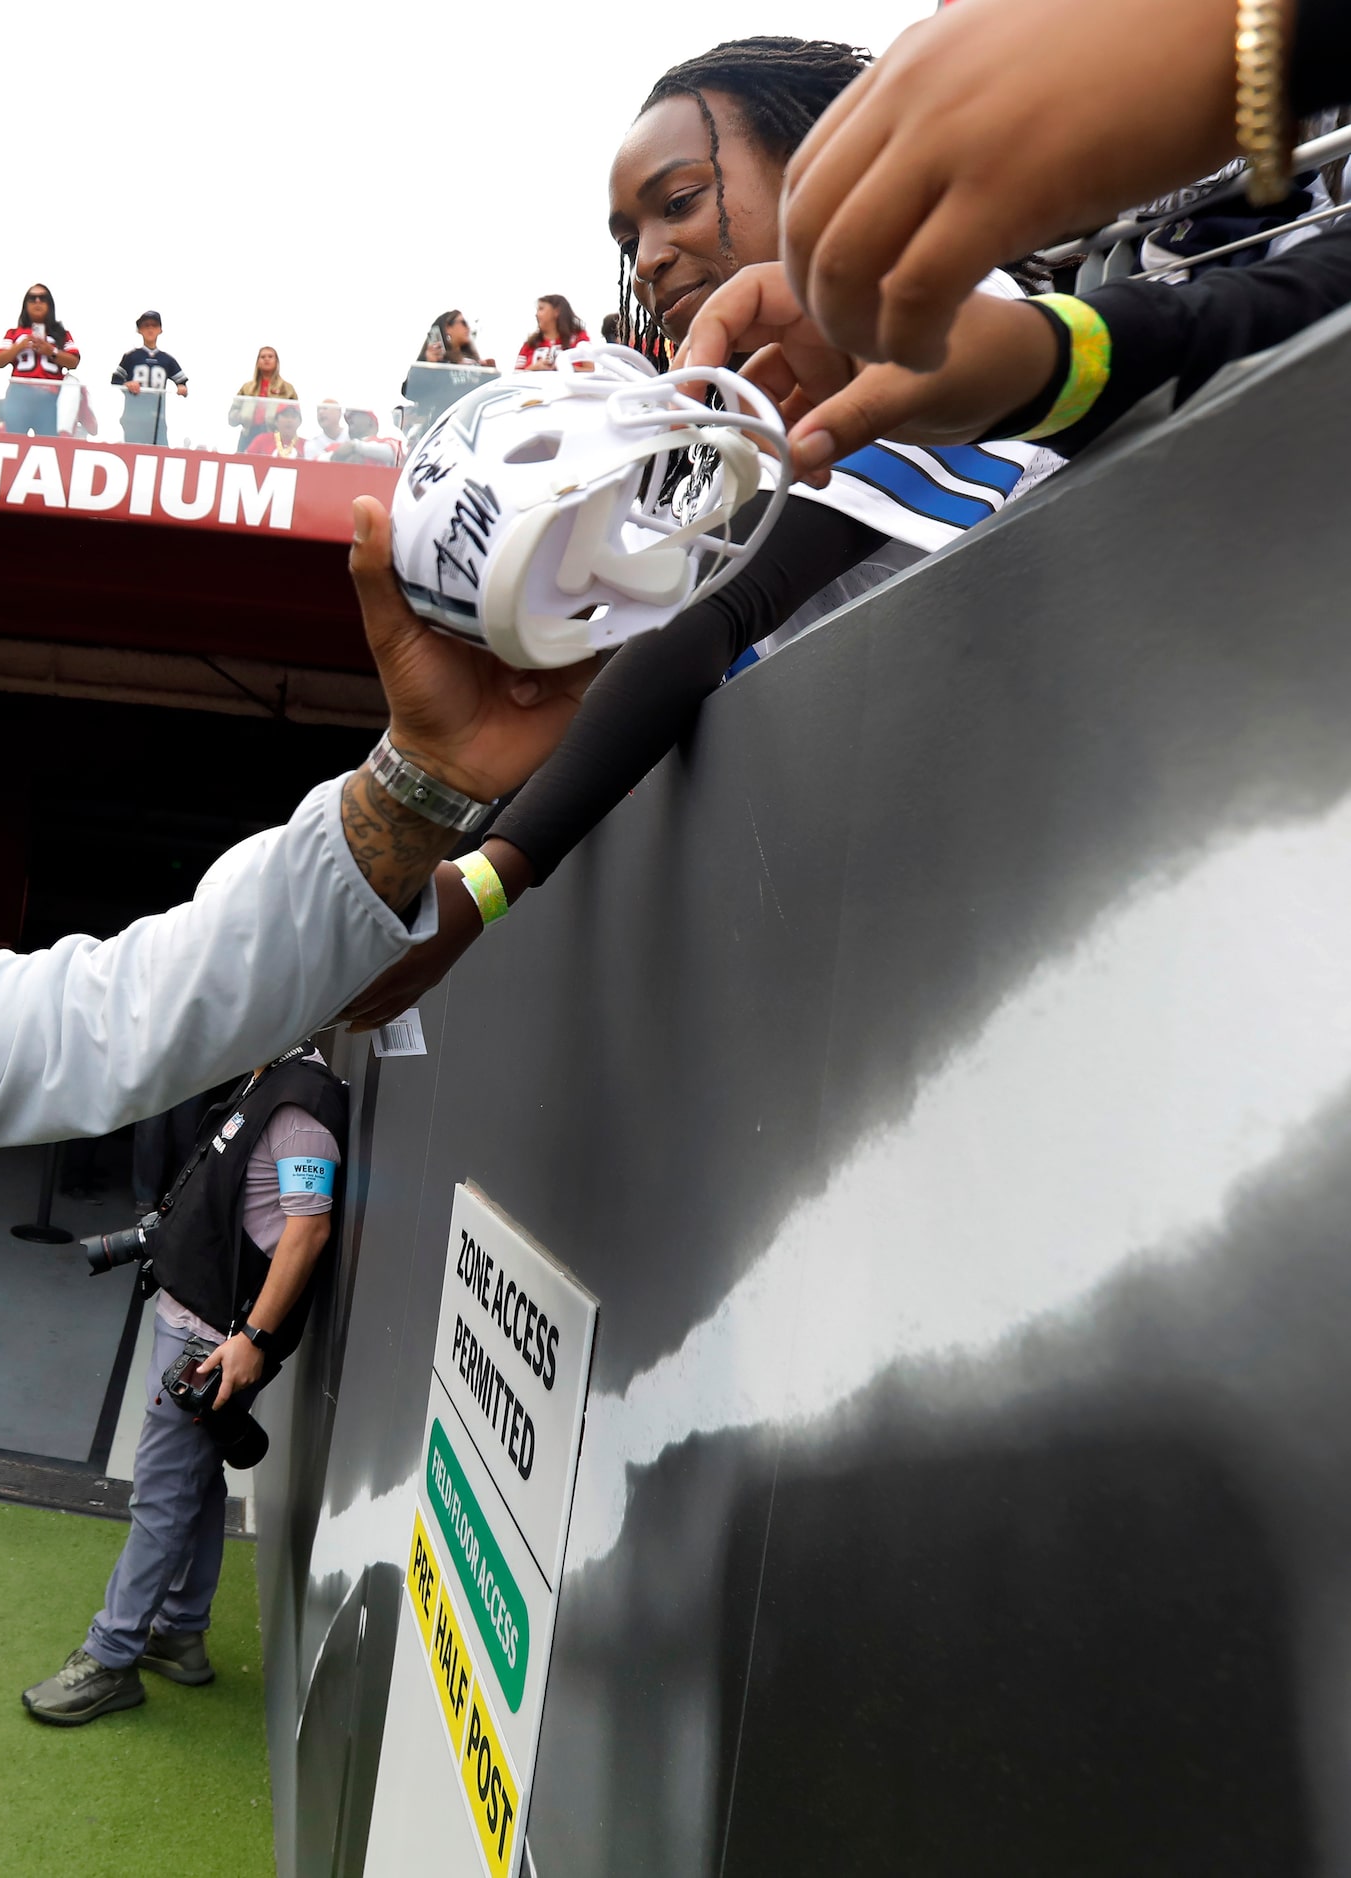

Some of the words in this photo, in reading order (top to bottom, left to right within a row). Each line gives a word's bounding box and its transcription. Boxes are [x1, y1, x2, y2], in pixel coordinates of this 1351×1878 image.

[270, 1045, 304, 1069] Canon
[294, 1164, 319, 1174] WEEK
[456, 1228, 494, 1312] ZONE
[491, 1268, 560, 1391] ACCESS
[452, 1312, 536, 1481] PERMITTED
[413, 1533, 434, 1621] PRE
[431, 1446, 480, 1580] FIELD/FLOOR
[476, 1556, 519, 1670] ACCESS
[435, 1601, 468, 1721] HALF
[466, 1702, 514, 1864] POST
